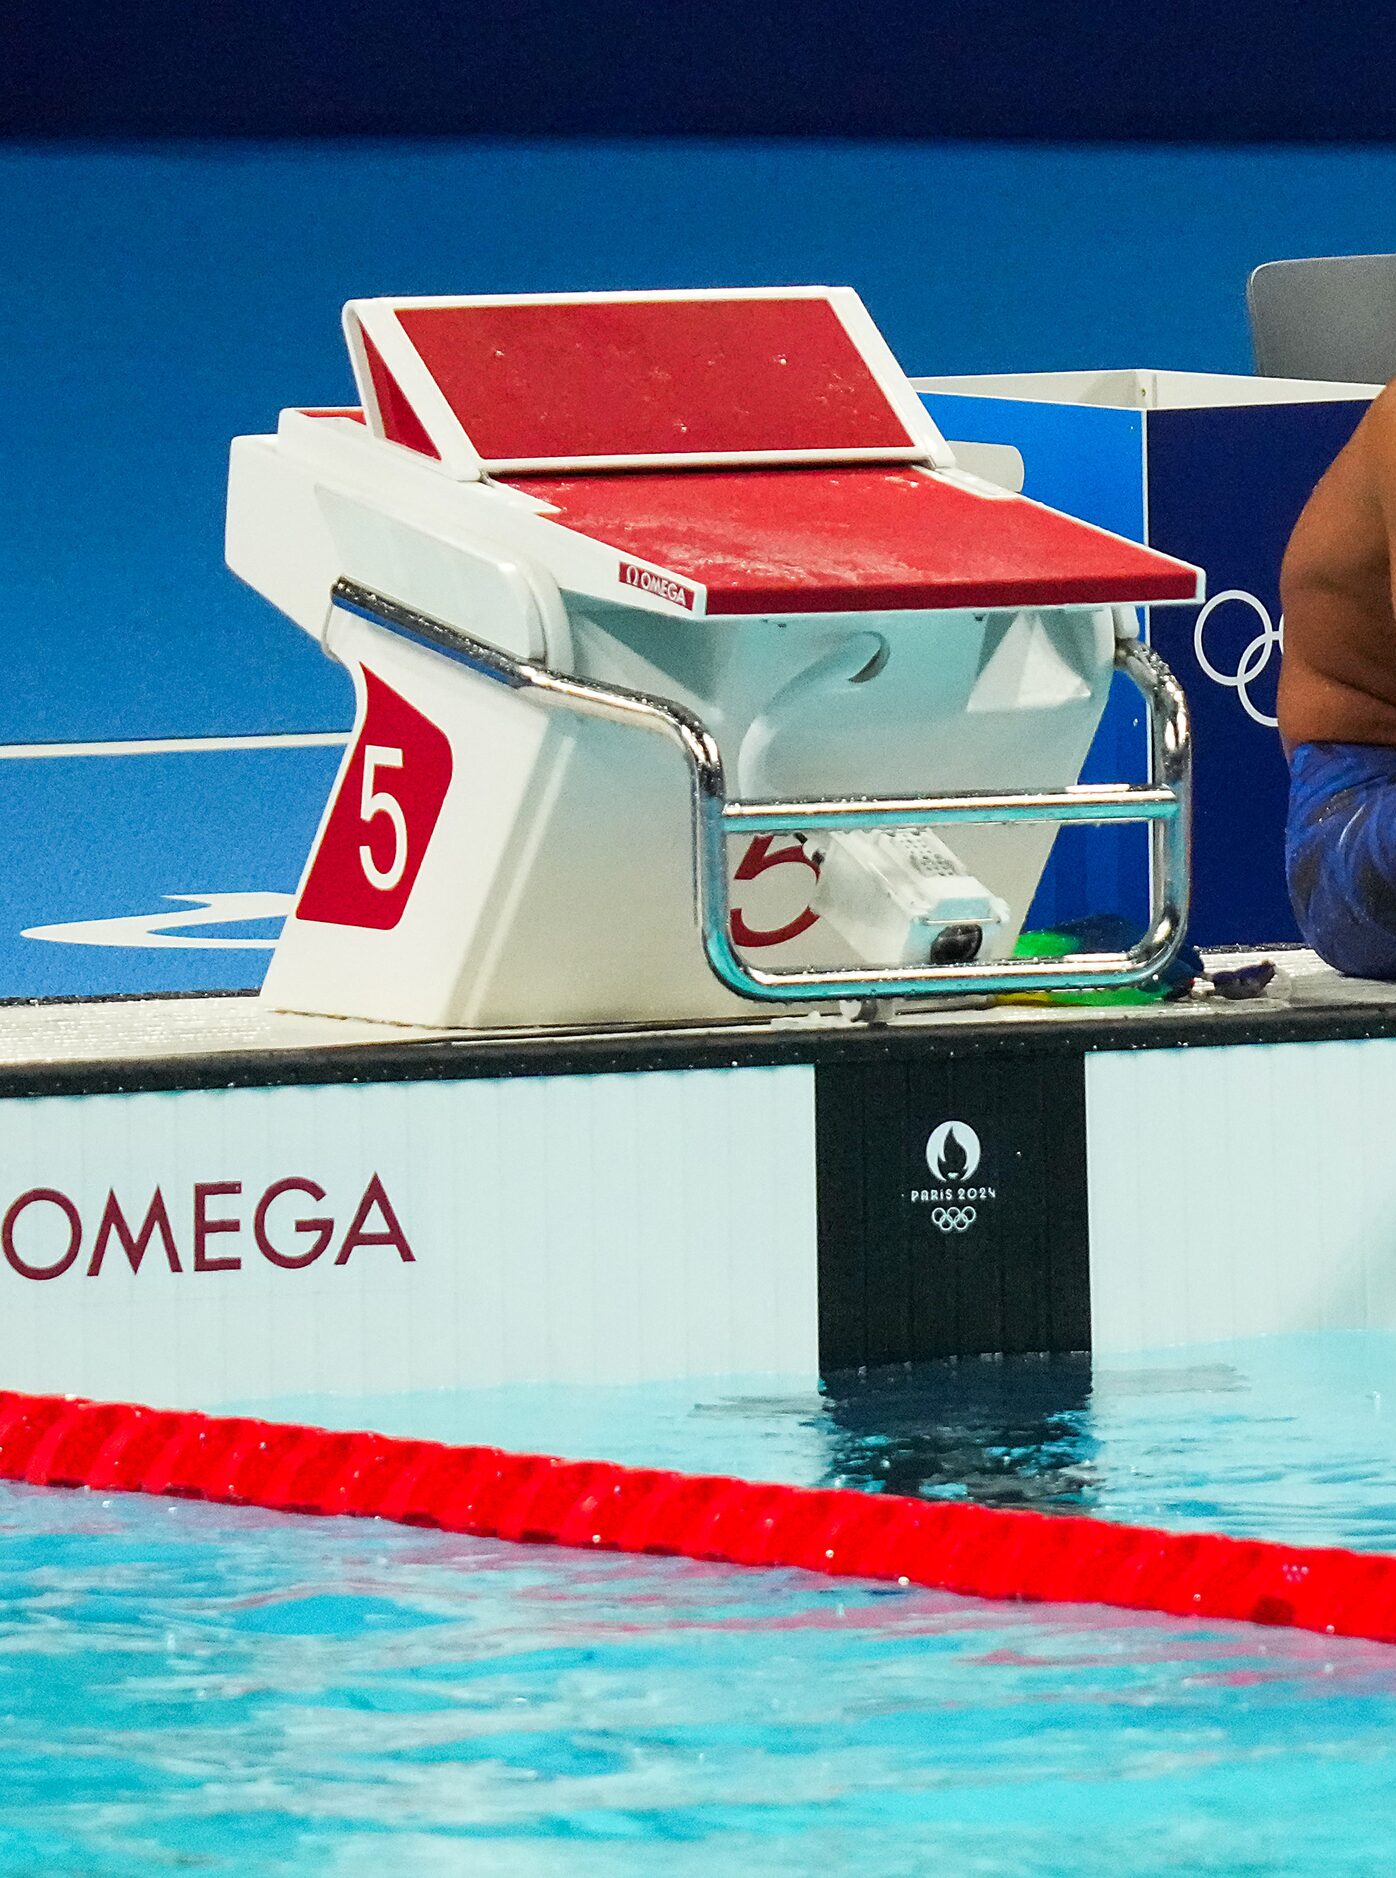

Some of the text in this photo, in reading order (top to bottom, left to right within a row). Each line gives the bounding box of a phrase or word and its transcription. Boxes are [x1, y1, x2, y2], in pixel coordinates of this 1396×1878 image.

[640, 572, 687, 606] OMEGA
[358, 744, 409, 892] 5
[729, 833, 821, 948] 5
[1, 1171, 417, 1281] OMEGA
[957, 1186, 997, 1200] 2024
